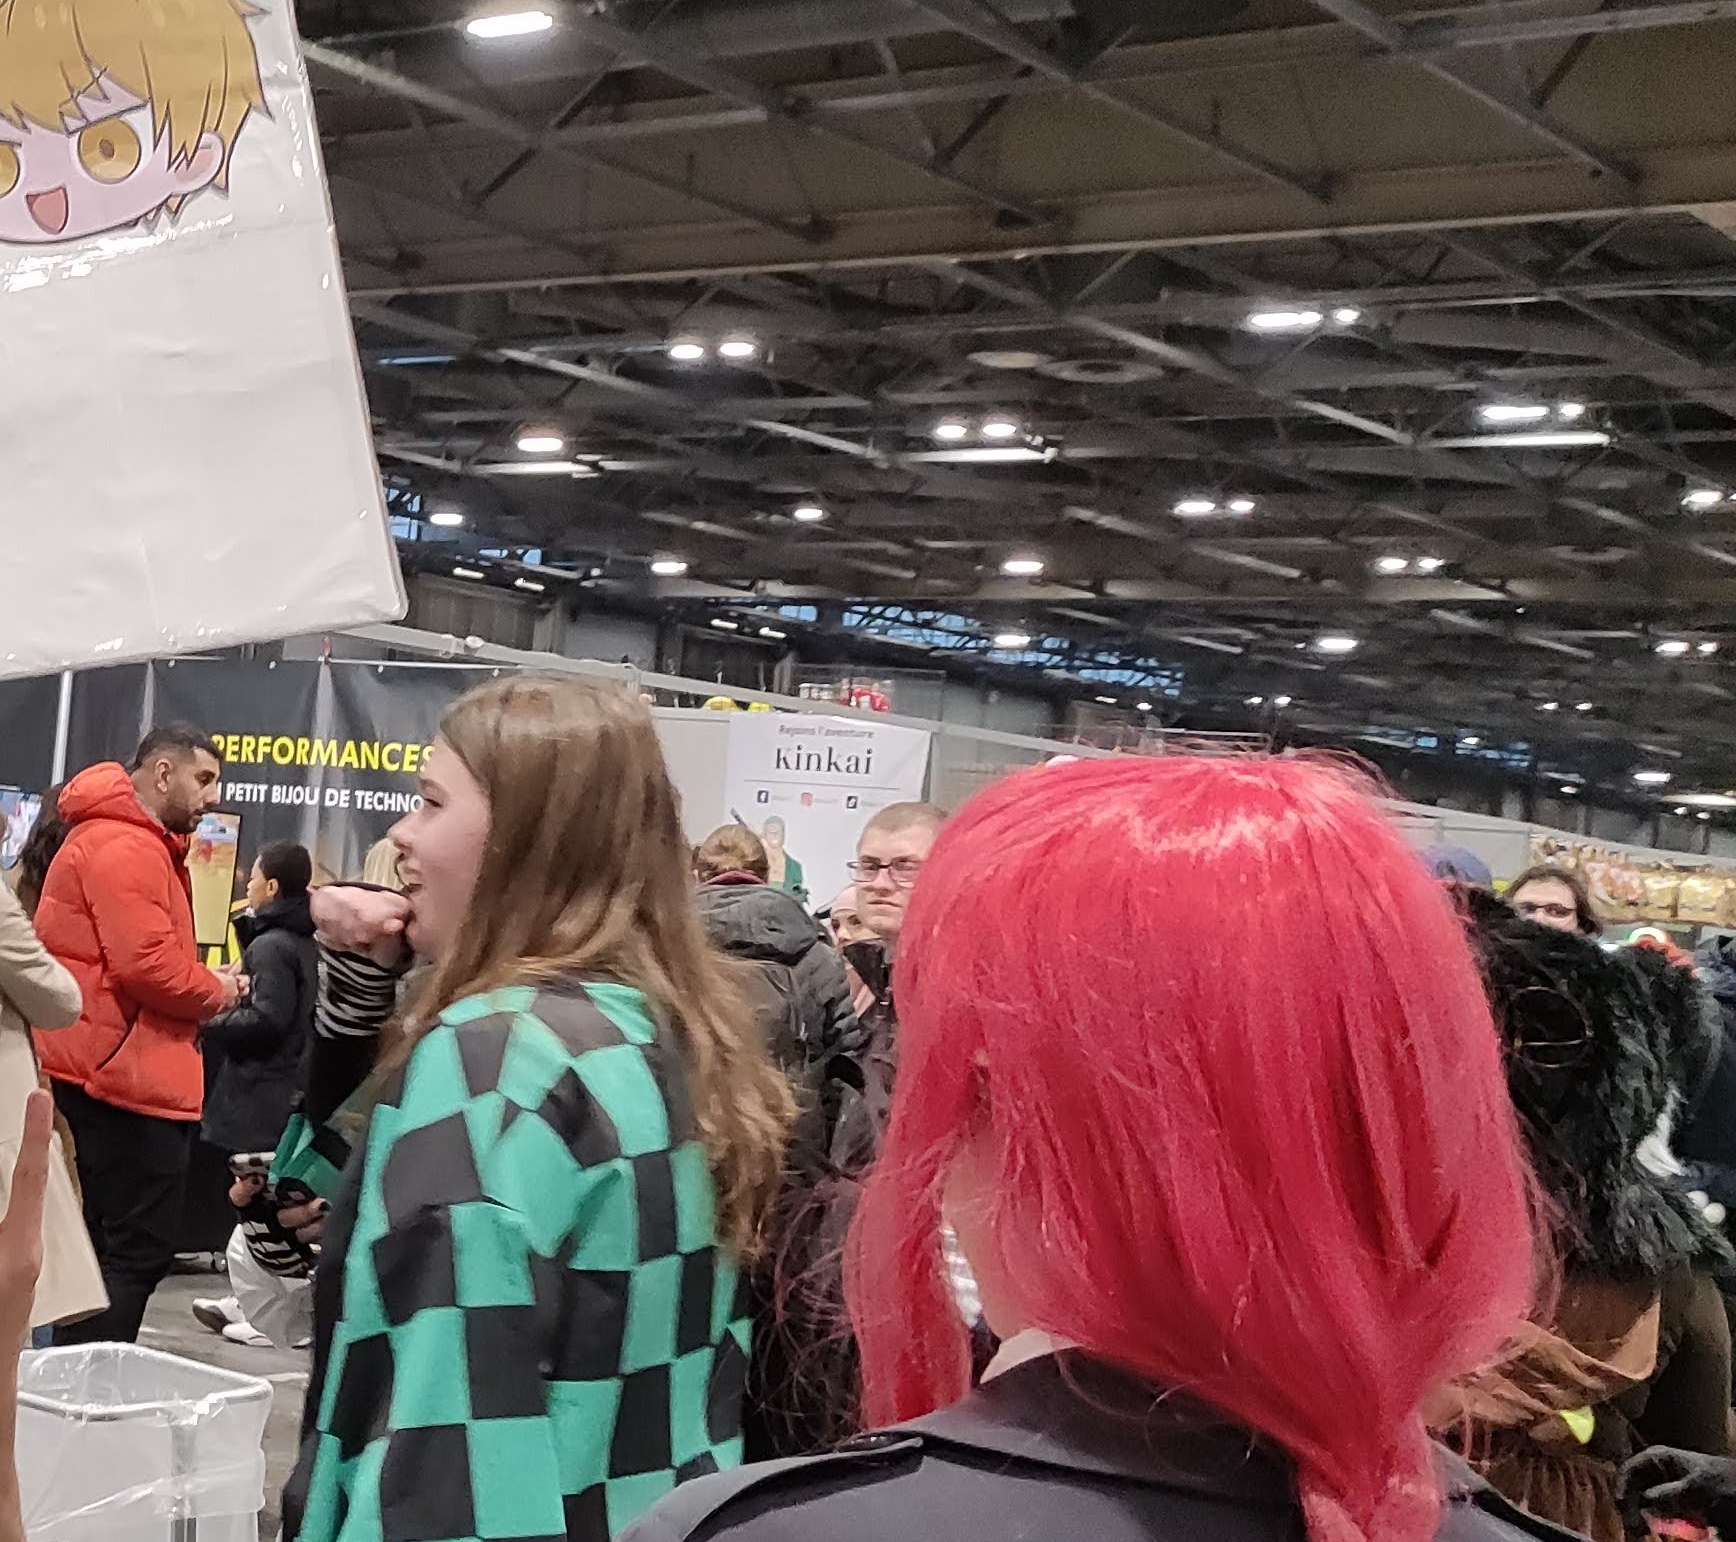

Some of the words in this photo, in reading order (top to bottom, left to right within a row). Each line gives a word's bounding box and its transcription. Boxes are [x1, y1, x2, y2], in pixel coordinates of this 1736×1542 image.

[211, 734, 436, 773] PERFORMANCES
[226, 782, 268, 803] PETIT
[272, 784, 319, 806] BIJOU
[324, 788, 352, 810] DE
